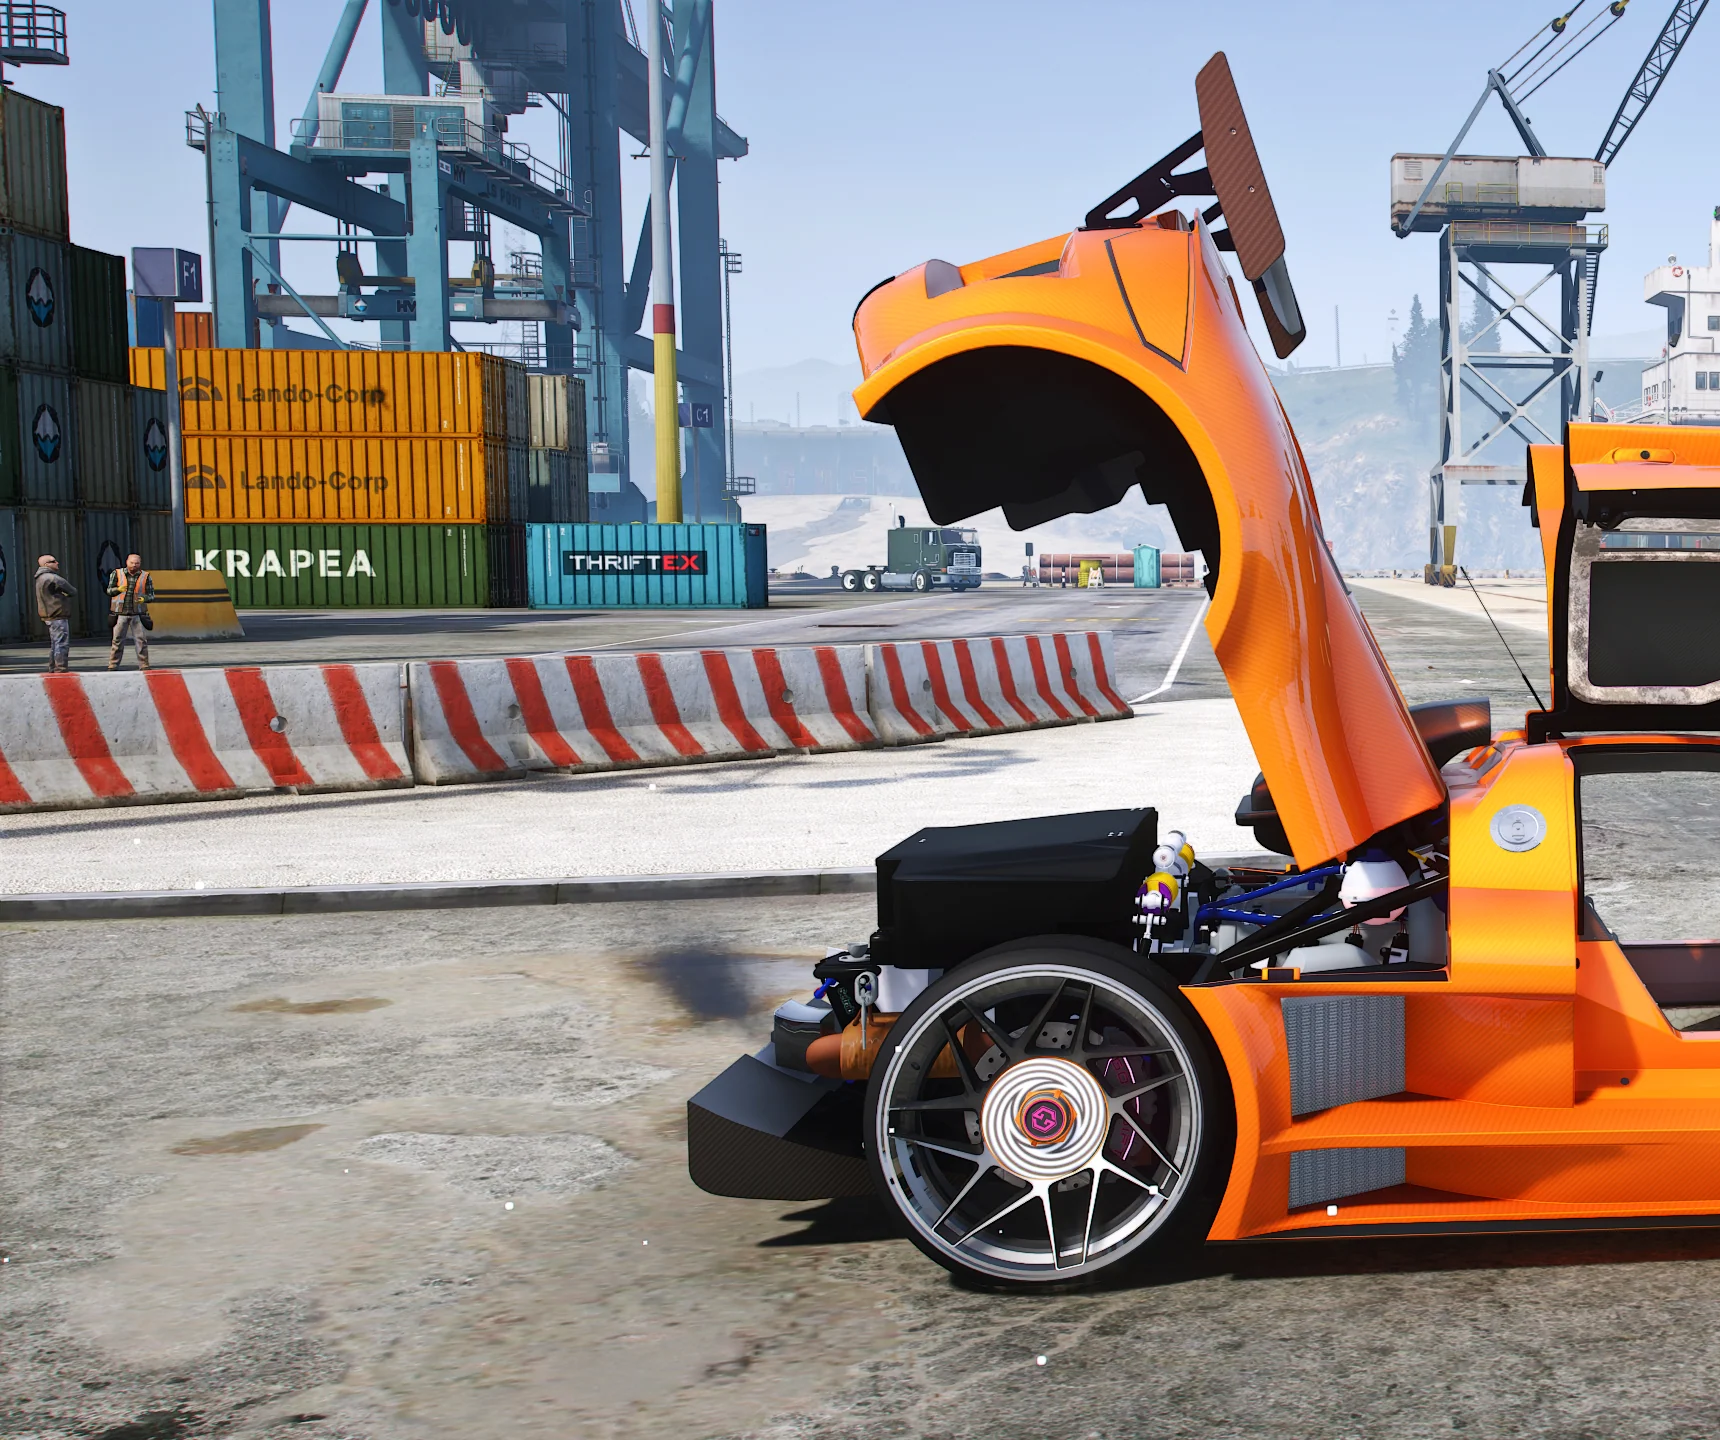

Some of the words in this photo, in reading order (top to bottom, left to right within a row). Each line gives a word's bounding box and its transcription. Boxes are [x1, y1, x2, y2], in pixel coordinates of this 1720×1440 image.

[182, 260, 198, 290] F1
[396, 299, 416, 313] HV
[236, 383, 386, 407] Lando-Corp
[696, 408, 709, 422] C1
[240, 471, 389, 494] Lando-Corp
[194, 549, 377, 578] KRAPEA
[569, 554, 700, 571] THRIFTEX
